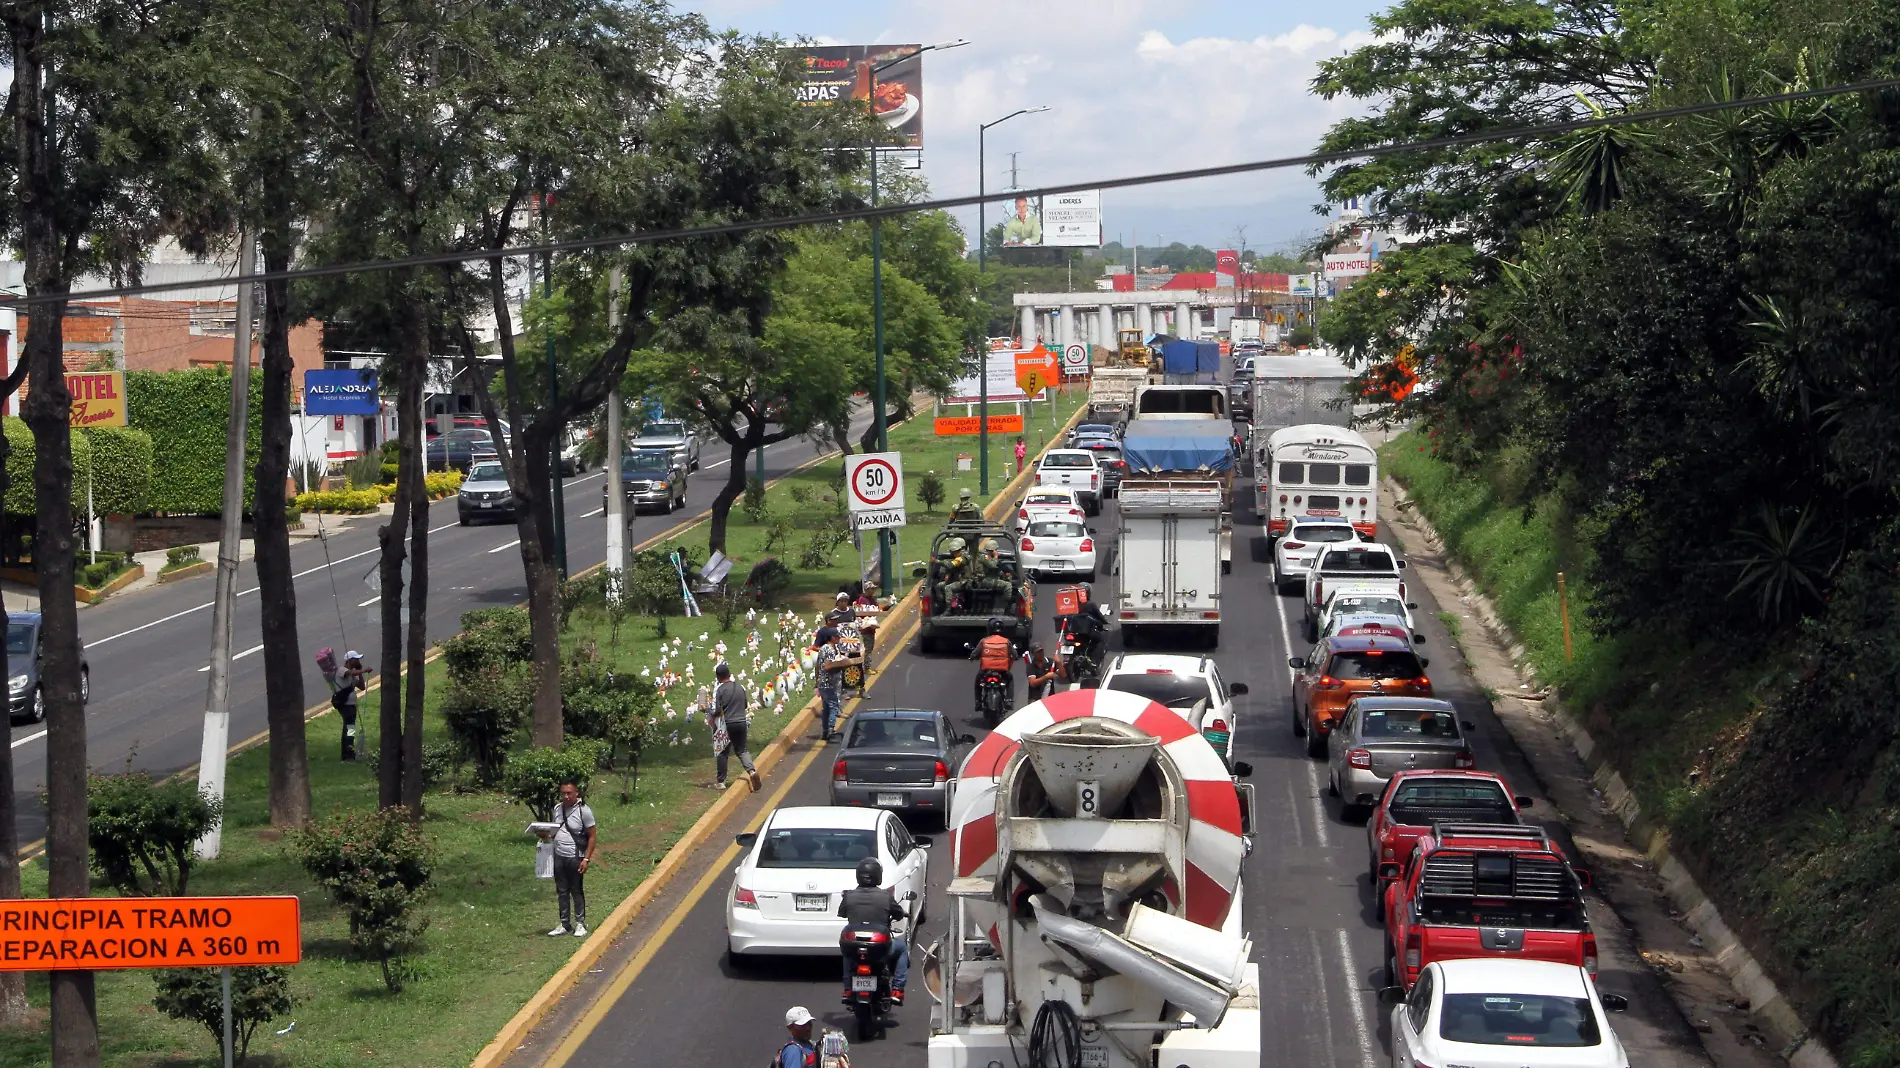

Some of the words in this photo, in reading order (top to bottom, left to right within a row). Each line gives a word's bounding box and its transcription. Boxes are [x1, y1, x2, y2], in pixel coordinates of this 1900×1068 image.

[1326, 261, 1345, 271] AUTO
[1346, 259, 1370, 270] HOTEL
[1071, 348, 1080, 357] 50
[64, 375, 117, 400] OTEL
[1307, 452, 1341, 460] Miradores
[866, 468, 884, 487] 50
[1081, 788, 1095, 812] 8
[0, 909, 124, 931] RINCIPIA
[132, 908, 232, 929] TRAMO
[0, 938, 167, 961] EPARACION
[176, 937, 195, 957] A
[203, 936, 247, 956] 360
[257, 939, 280, 954] m
